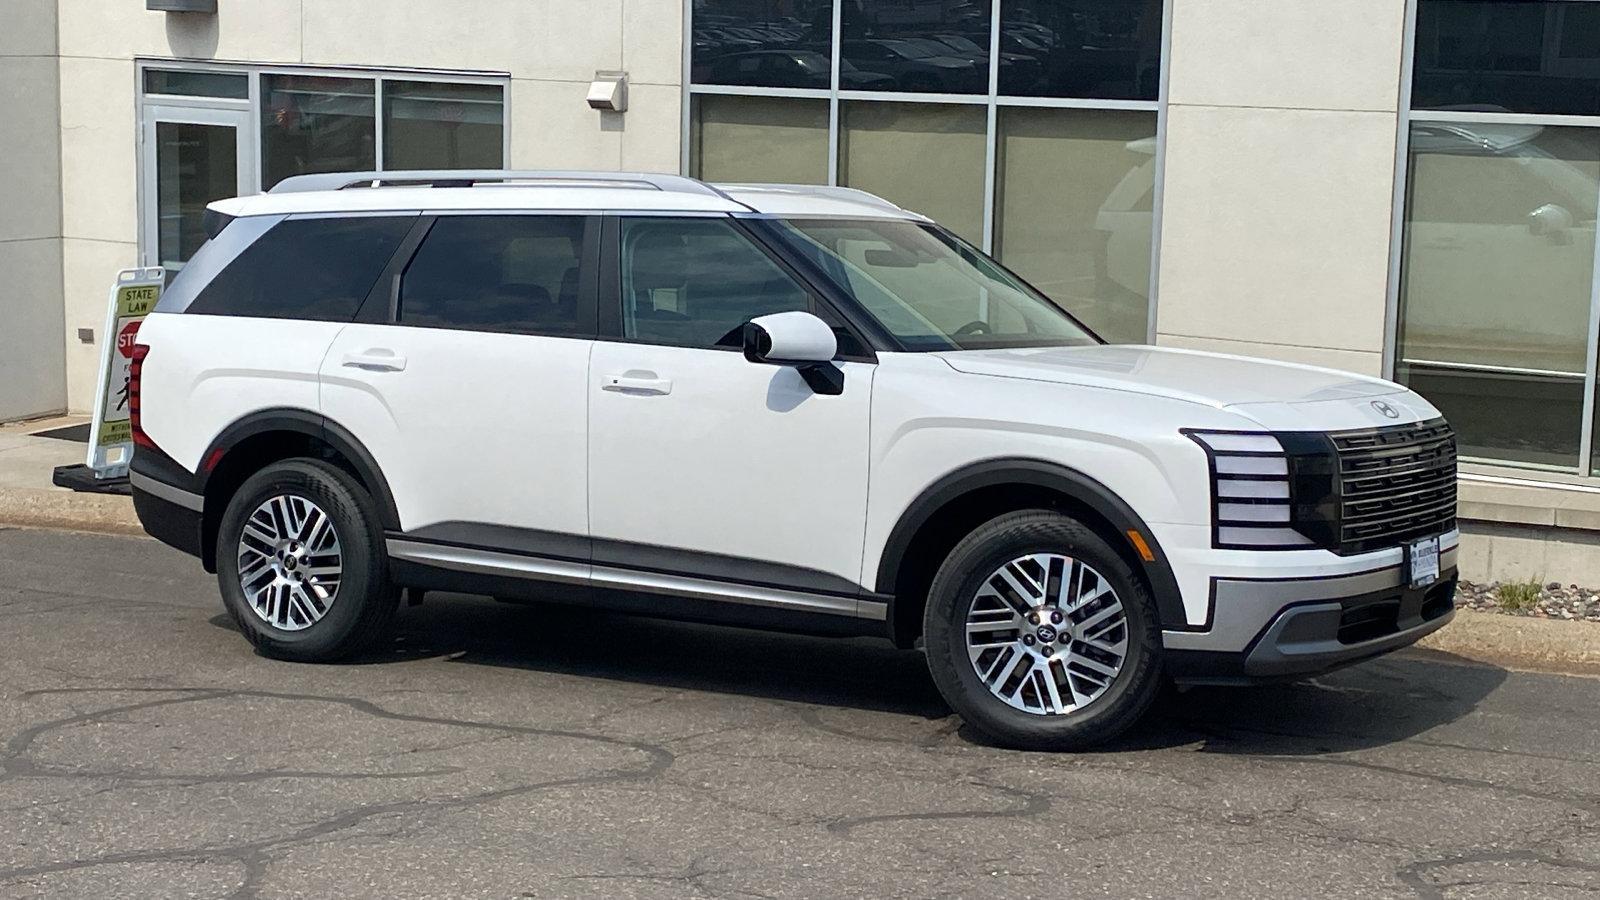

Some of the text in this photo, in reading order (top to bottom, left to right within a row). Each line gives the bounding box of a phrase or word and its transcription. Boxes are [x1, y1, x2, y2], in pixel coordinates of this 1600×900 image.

[126, 289, 153, 300] STATE
[128, 302, 148, 313] LAW
[119, 333, 136, 348] ST
